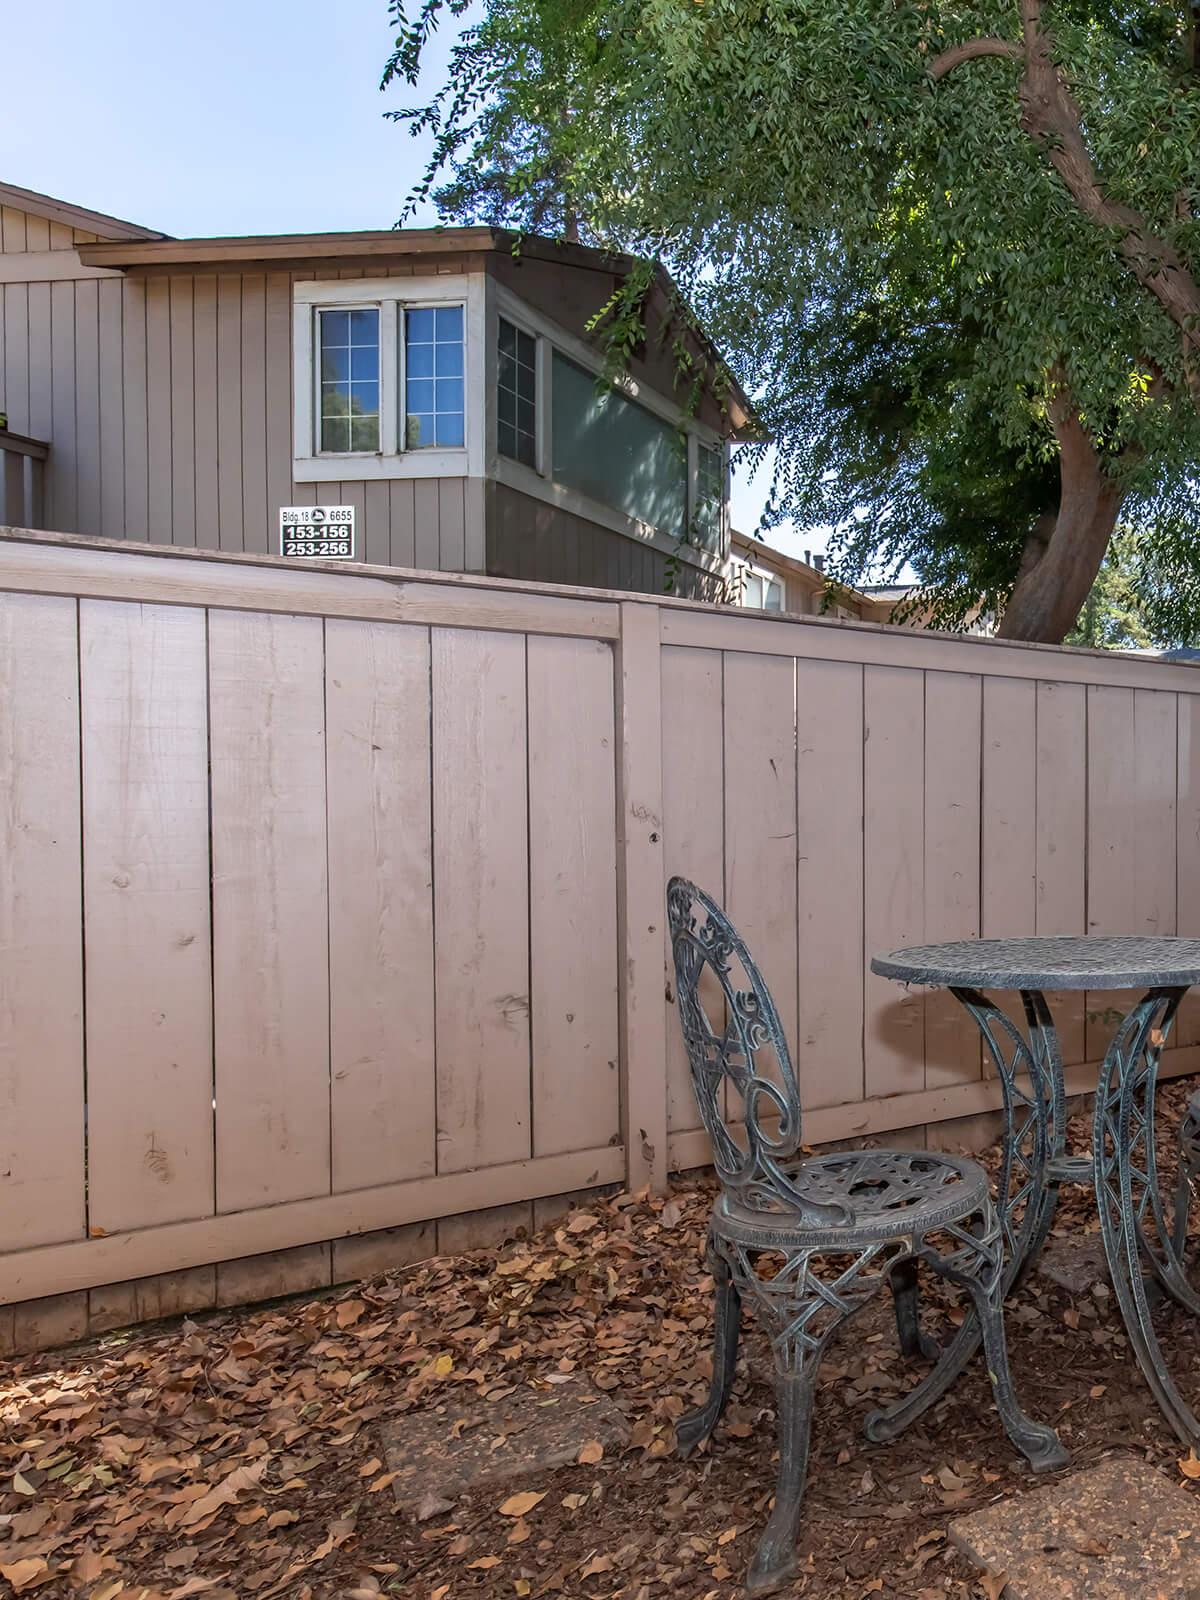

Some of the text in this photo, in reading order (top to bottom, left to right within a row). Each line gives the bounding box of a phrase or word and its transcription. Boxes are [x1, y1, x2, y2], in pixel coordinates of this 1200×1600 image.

[301, 511, 310, 521] 18
[330, 510, 352, 521] 6655
[287, 526, 348, 539] 153-156
[286, 542, 348, 555] 253-256
